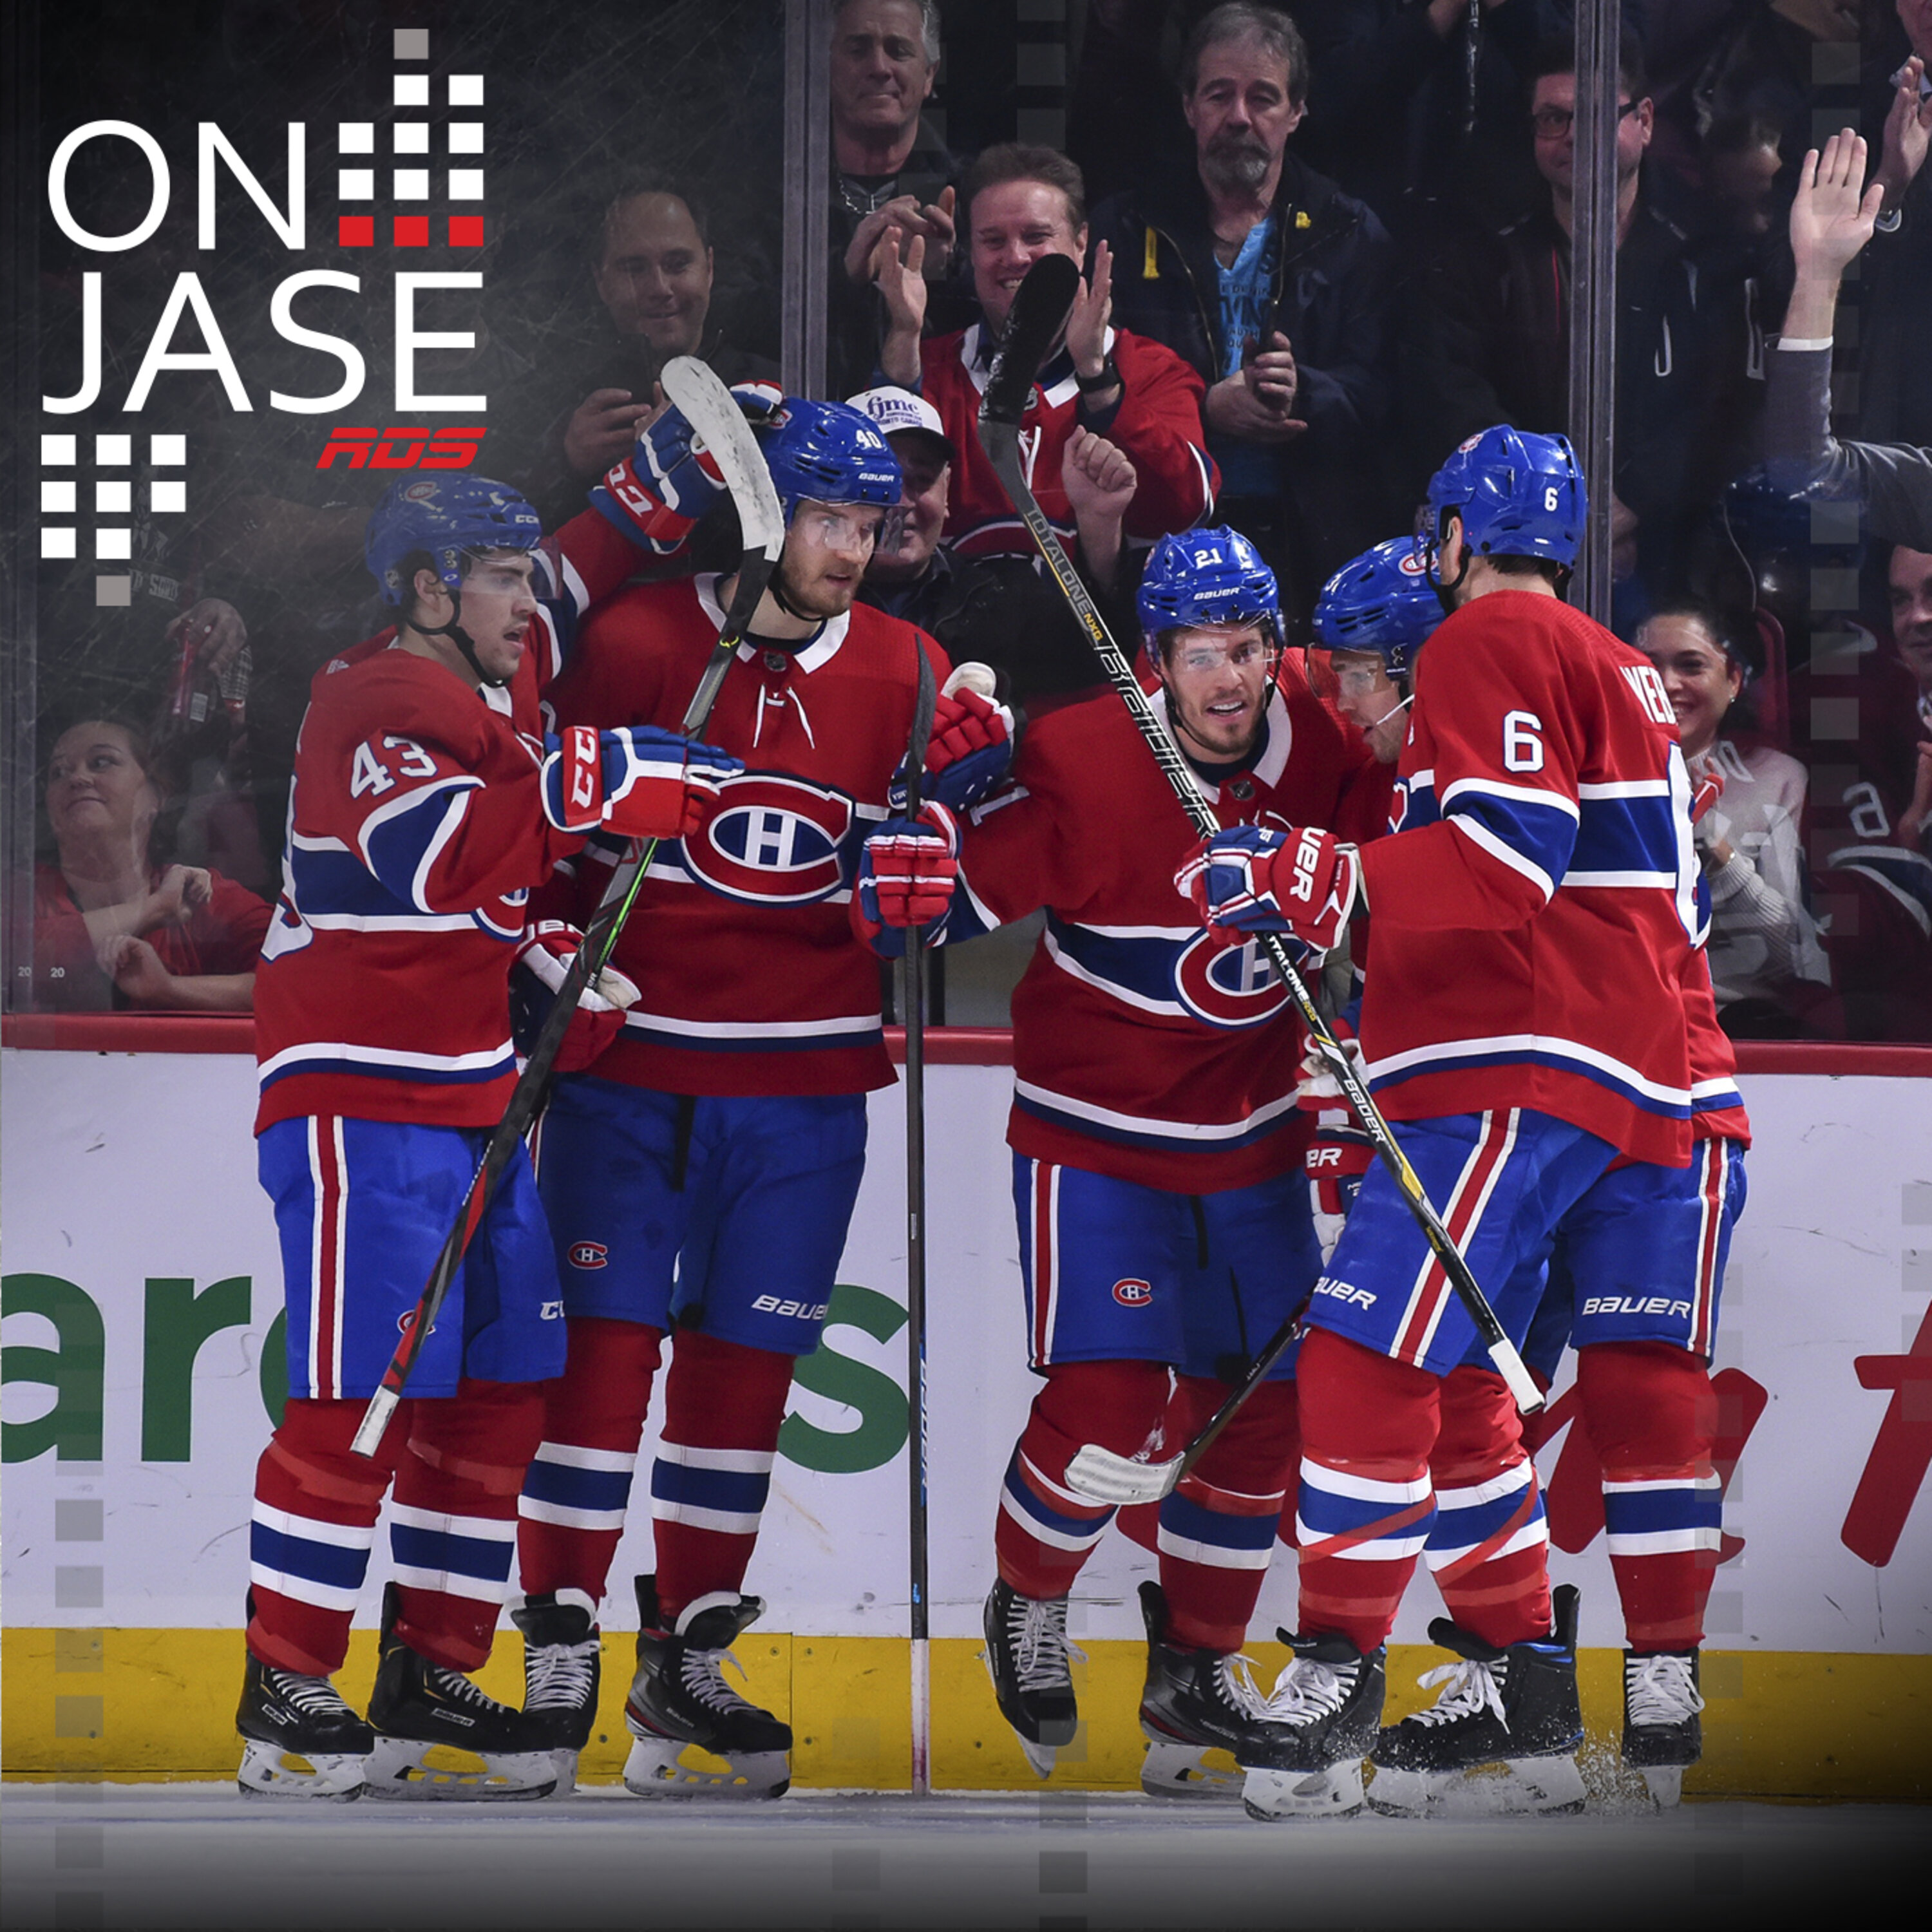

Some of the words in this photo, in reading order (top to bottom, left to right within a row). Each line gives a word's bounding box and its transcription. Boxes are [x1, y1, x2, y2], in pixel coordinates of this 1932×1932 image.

[867, 396, 919, 420] fjmc
[856, 429, 883, 450] 40
[858, 472, 895, 482] BAUER
[1545, 487, 1558, 512] 6
[1194, 547, 1224, 569] 21
[1193, 587, 1240, 601] BAUER
[1503, 710, 1544, 772] 6
[350, 735, 439, 799] 43
[970, 786, 1030, 827] 1
[1289, 826, 1328, 902] UER
[18, 967, 32, 978] 20
[51, 967, 65, 978] 20
[1343, 1079, 1386, 1142] BAUER
[1306, 1147, 1343, 1168] ER
[750, 1294, 829, 1320] BAUE
[1582, 1296, 1692, 1320] BAUER
